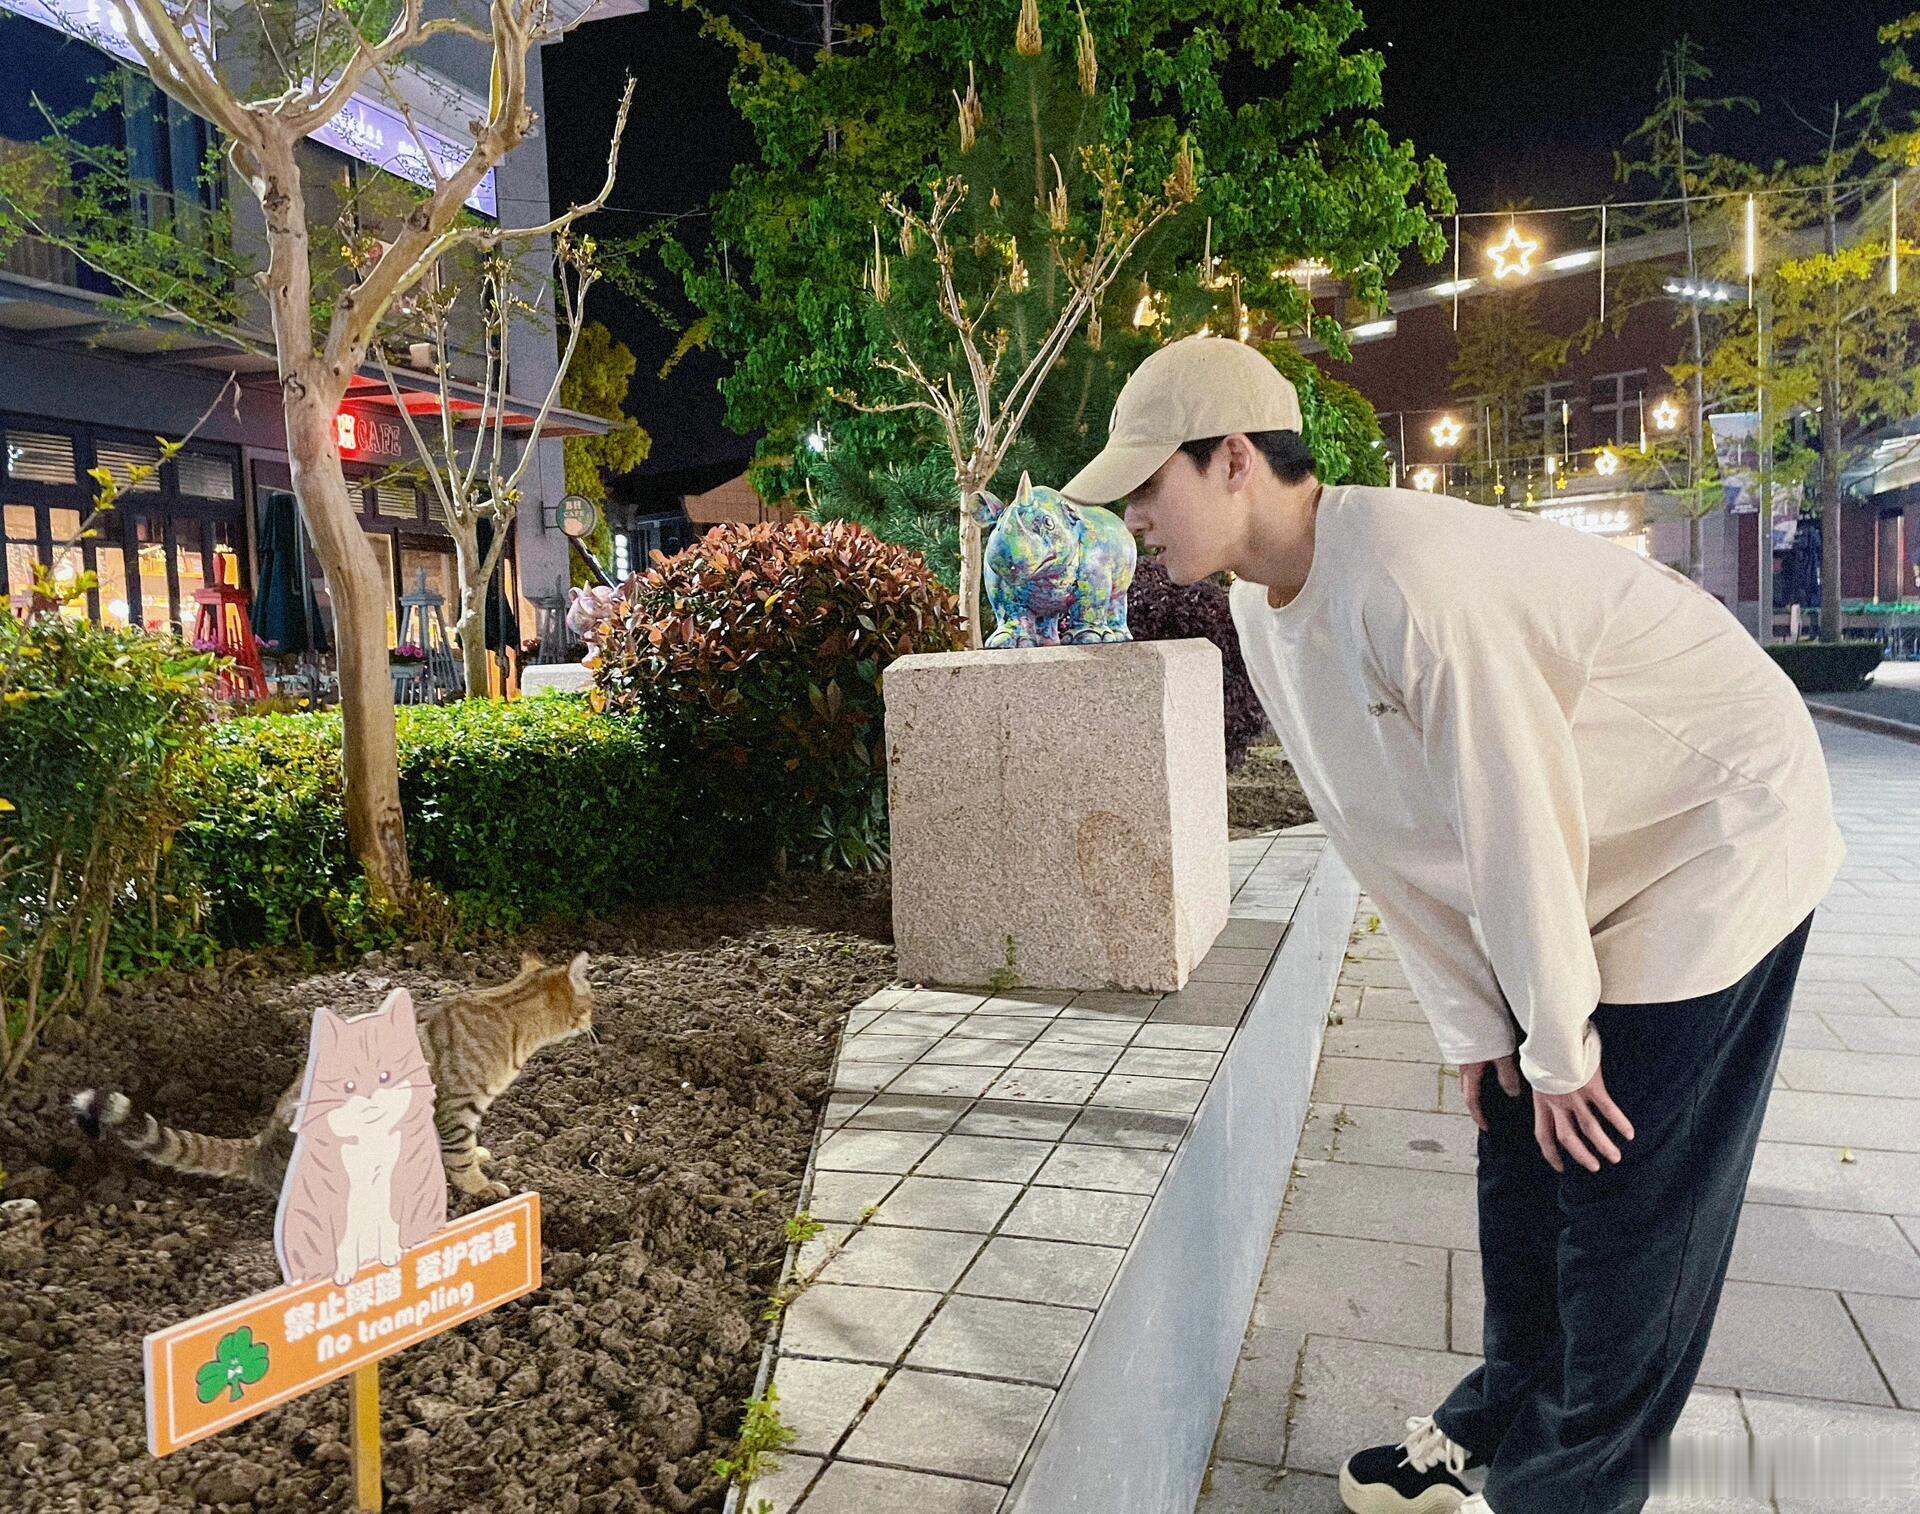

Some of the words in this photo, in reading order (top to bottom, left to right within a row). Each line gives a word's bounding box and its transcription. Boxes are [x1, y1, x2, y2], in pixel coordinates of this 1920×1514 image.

[357, 419, 402, 457] CAFE
[563, 510, 585, 518] CAFE
[565, 500, 582, 510] BH
[284, 1265, 403, 1344] 禁止踩踏
[415, 1221, 518, 1290] 爱护花草
[316, 1332, 353, 1363] No
[357, 1281, 475, 1344] trampling
